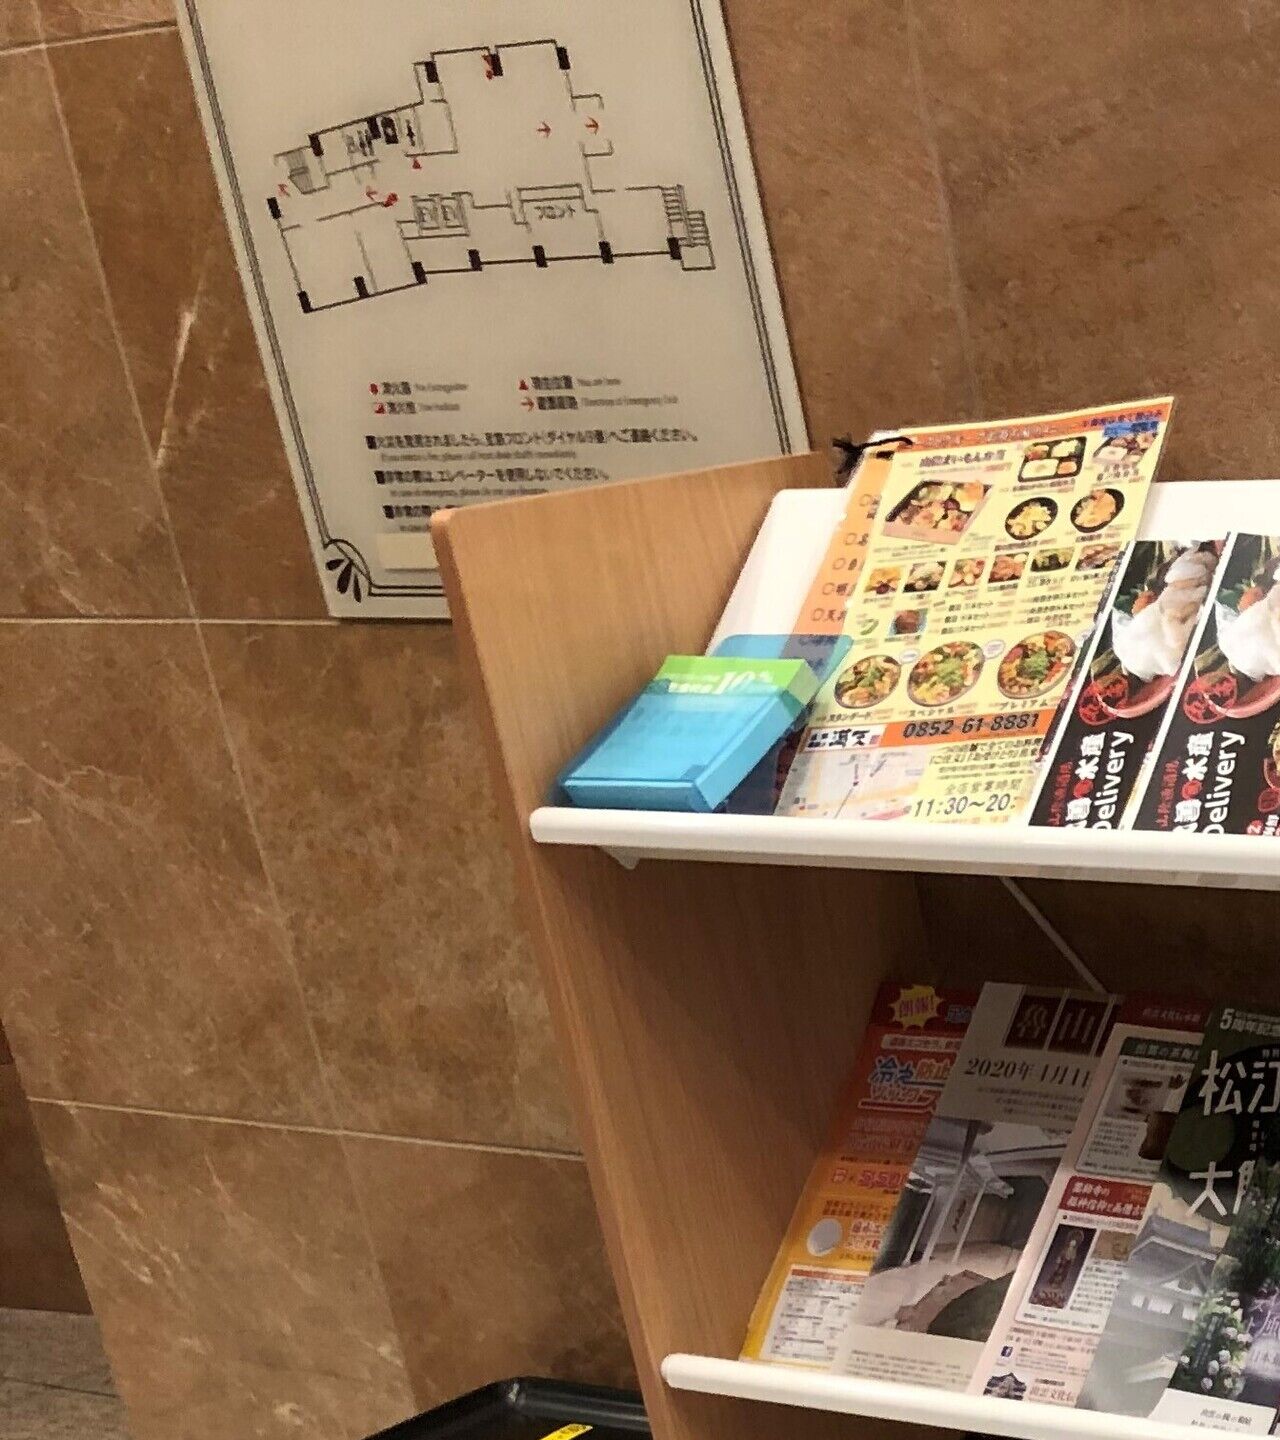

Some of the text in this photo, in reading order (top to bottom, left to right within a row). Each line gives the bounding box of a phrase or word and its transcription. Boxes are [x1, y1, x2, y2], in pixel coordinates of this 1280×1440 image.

[1092, 731, 1134, 830] Delivery
[1204, 731, 1245, 834] Delivery
[964, 1057, 1036, 1081] 2020年
